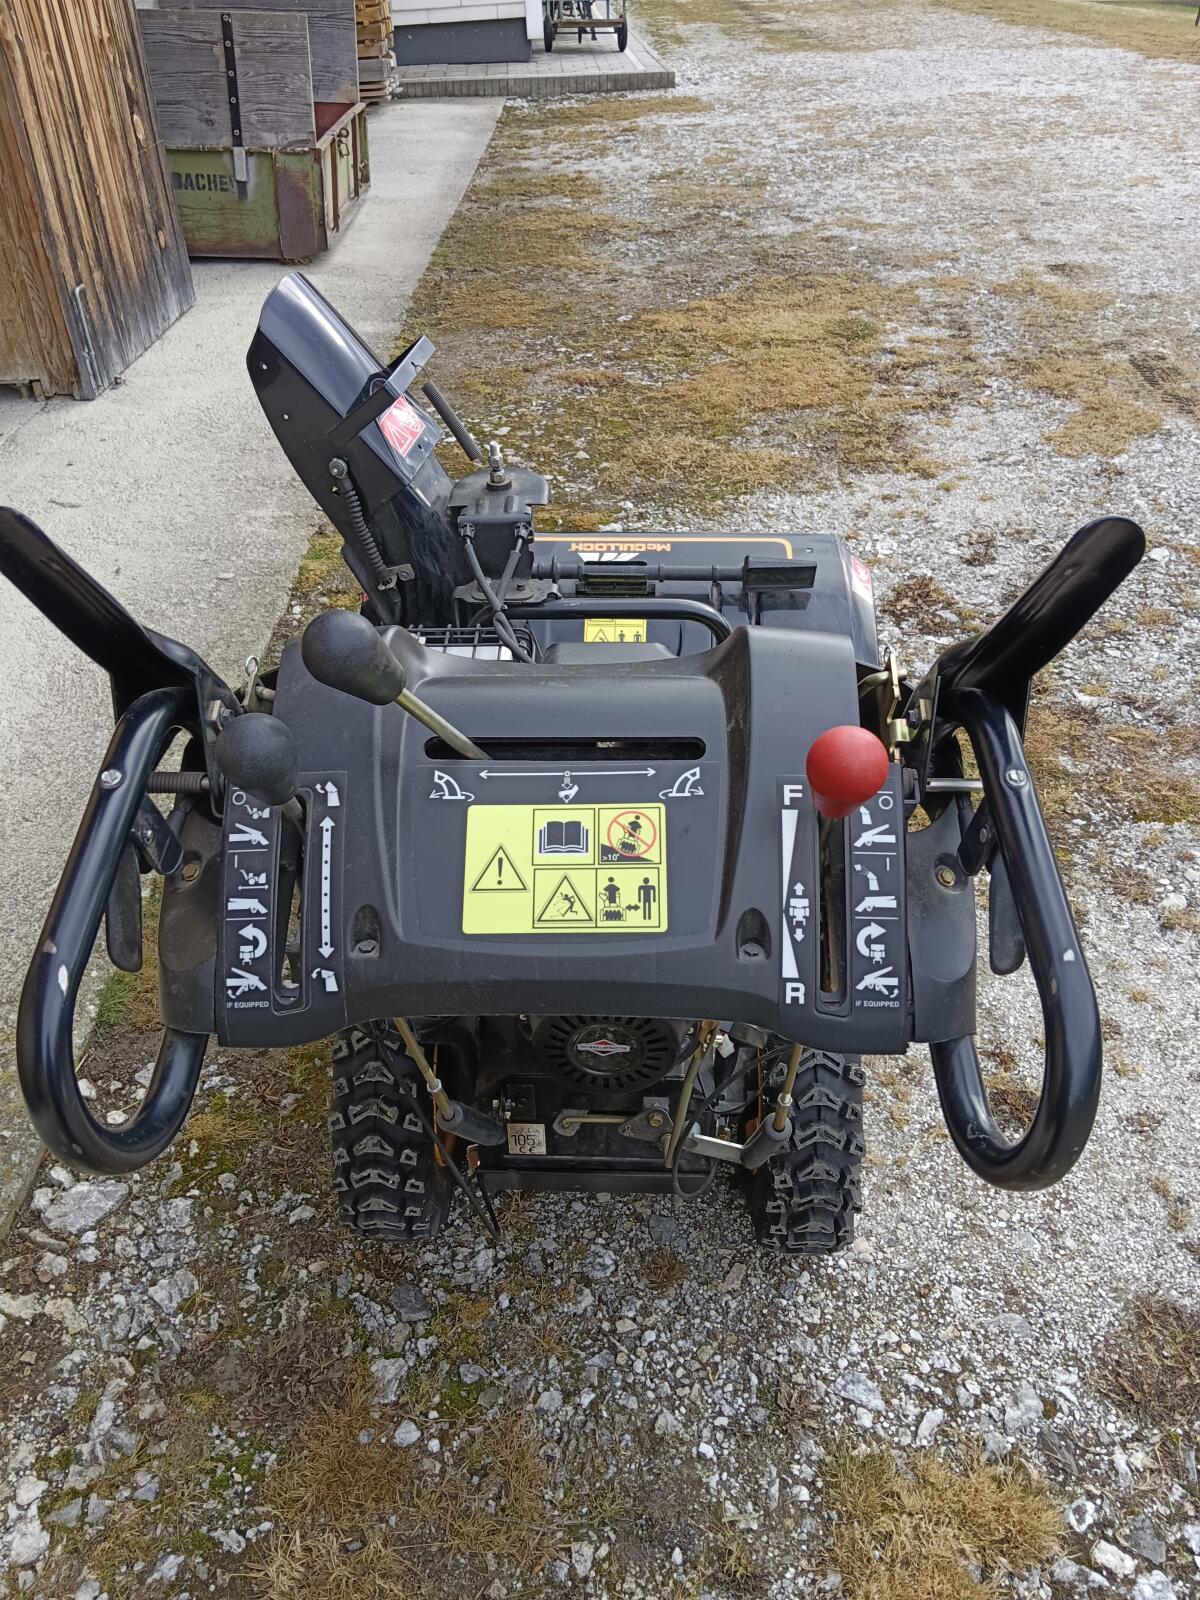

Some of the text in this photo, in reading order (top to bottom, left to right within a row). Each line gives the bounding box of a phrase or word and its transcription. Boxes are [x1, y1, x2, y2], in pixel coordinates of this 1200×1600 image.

[783, 784, 803, 806] F
[785, 982, 805, 1005] R
[226, 1000, 270, 1009] IF EQUIPPED
[863, 1000, 900, 1008] EQUIPPED
[511, 1134, 535, 1146] 105
